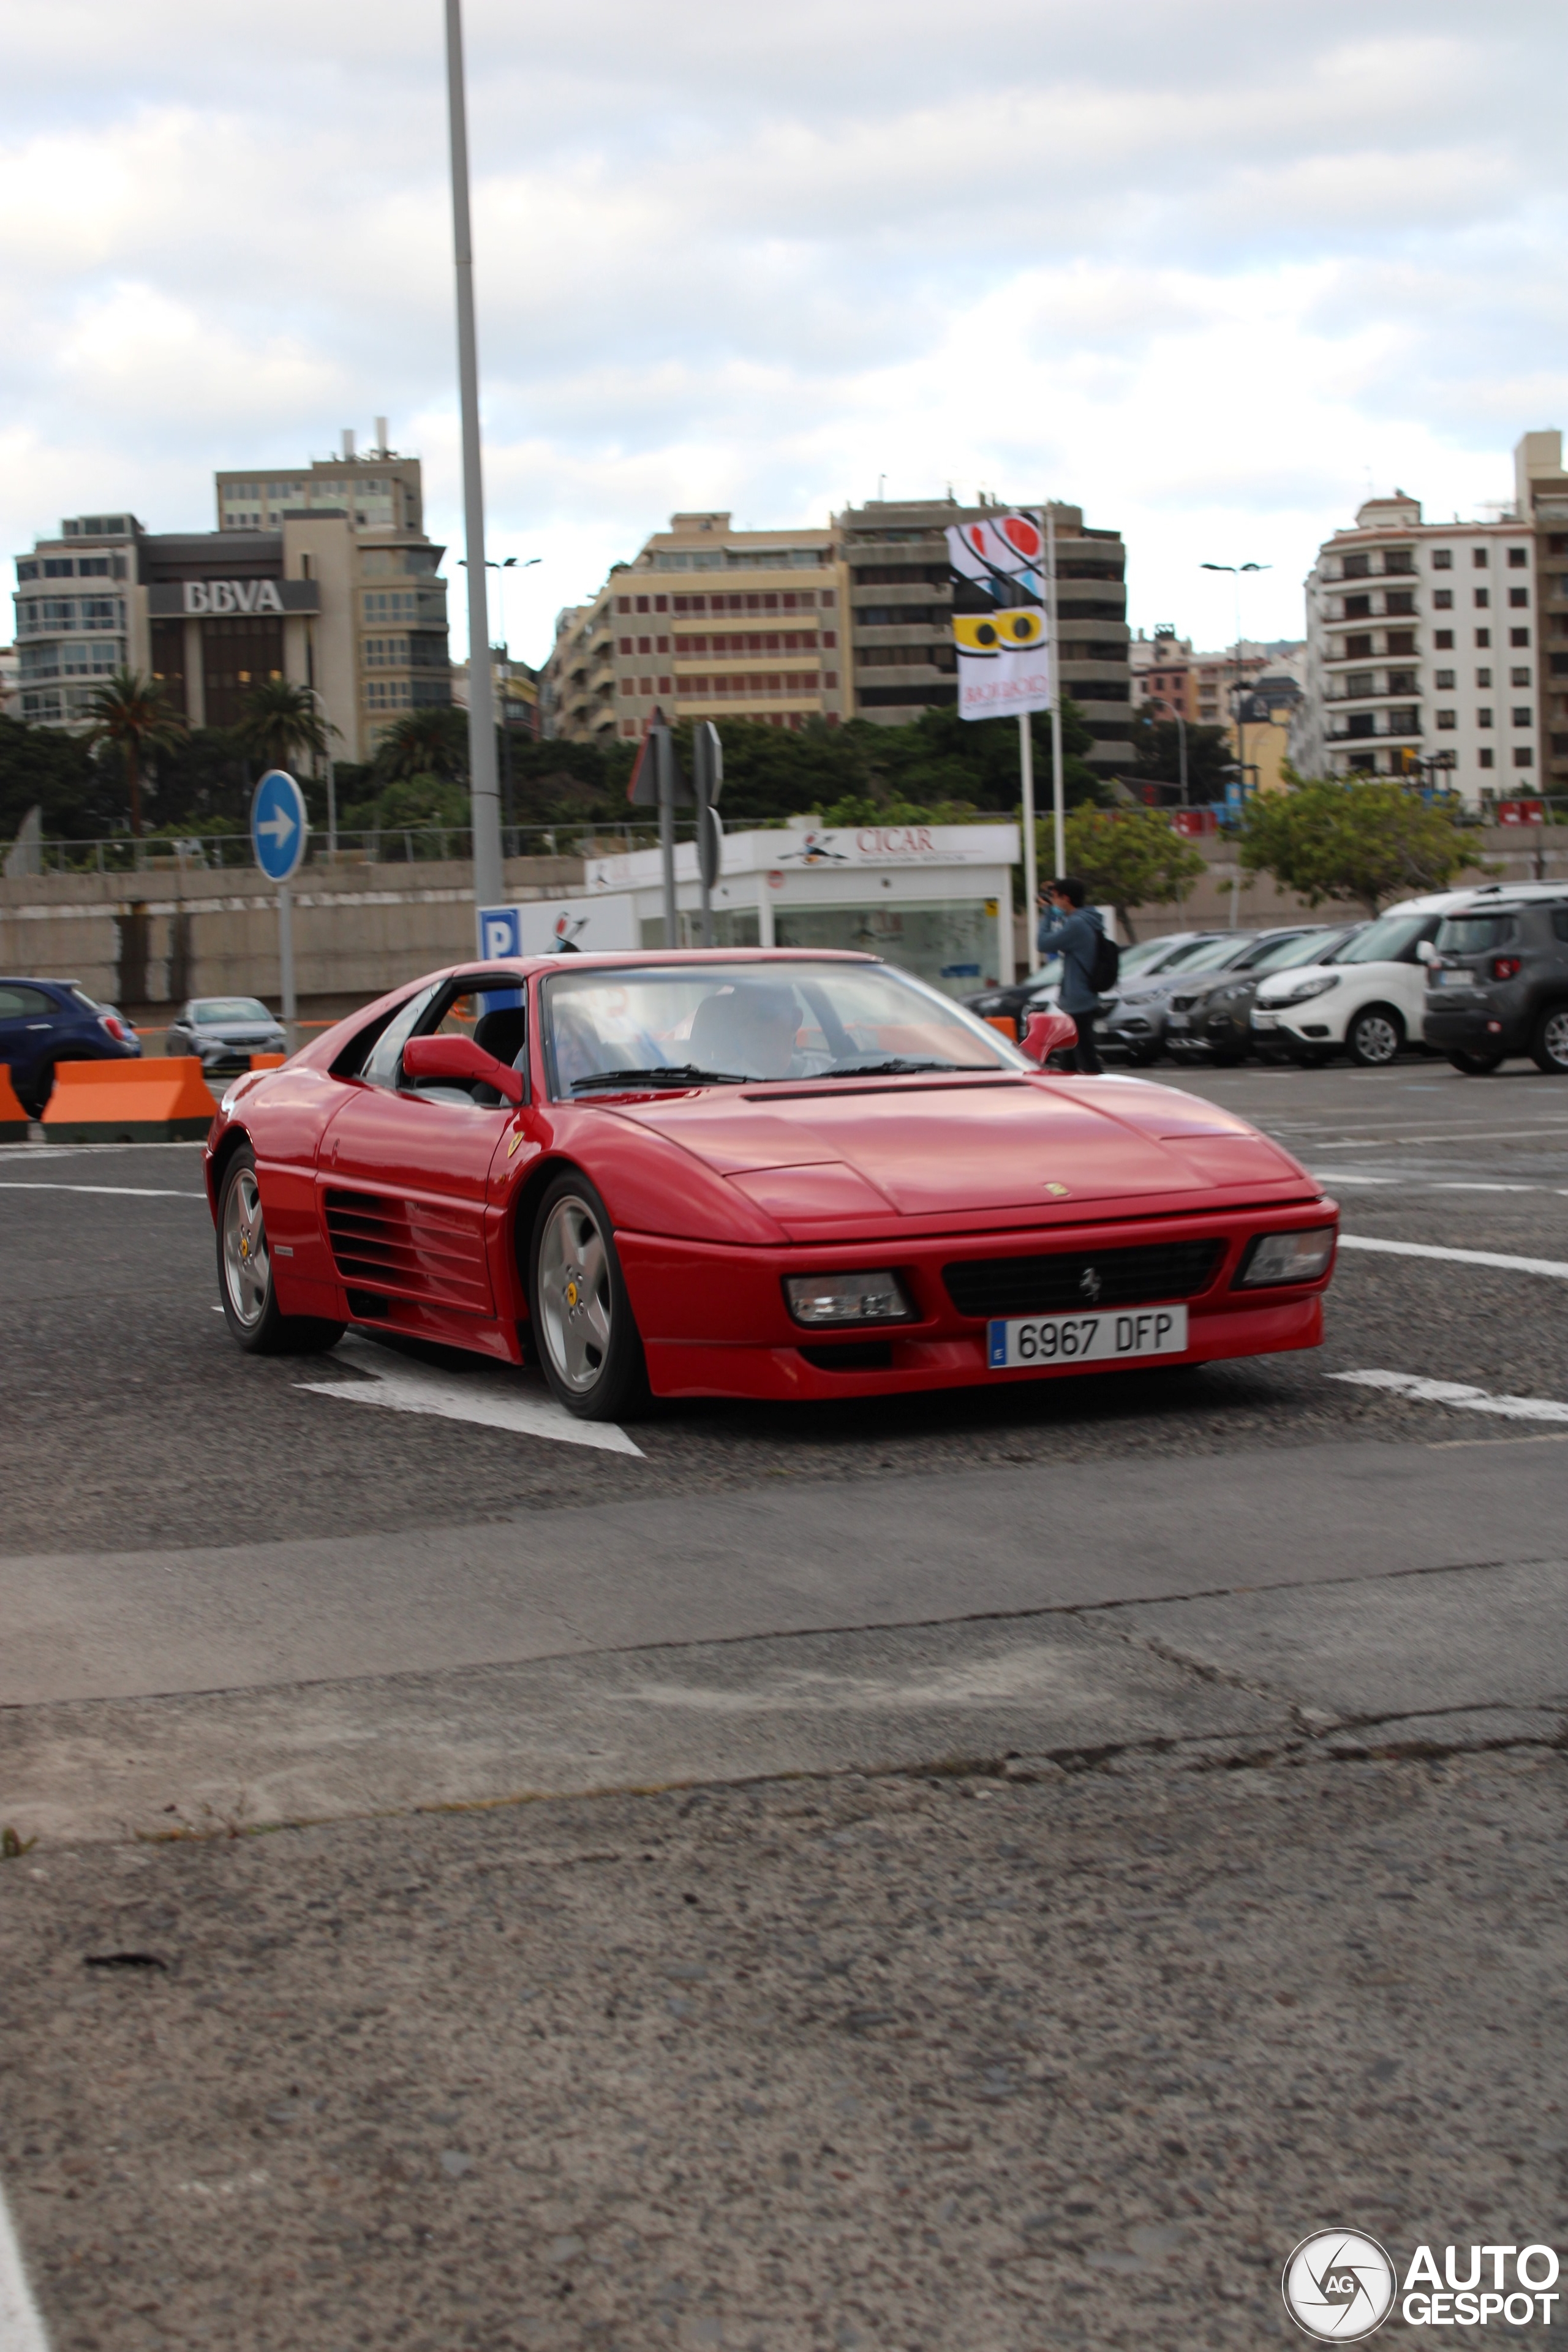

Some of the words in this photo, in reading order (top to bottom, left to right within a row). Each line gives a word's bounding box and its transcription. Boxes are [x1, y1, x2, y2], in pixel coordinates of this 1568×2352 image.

[183, 579, 284, 612] BBVA
[856, 827, 934, 853] CICAR
[487, 921, 513, 958] P
[993, 1349, 1004, 1360] E
[1018, 1319, 1099, 1359] 6967
[1115, 1313, 1172, 1352] DFP
